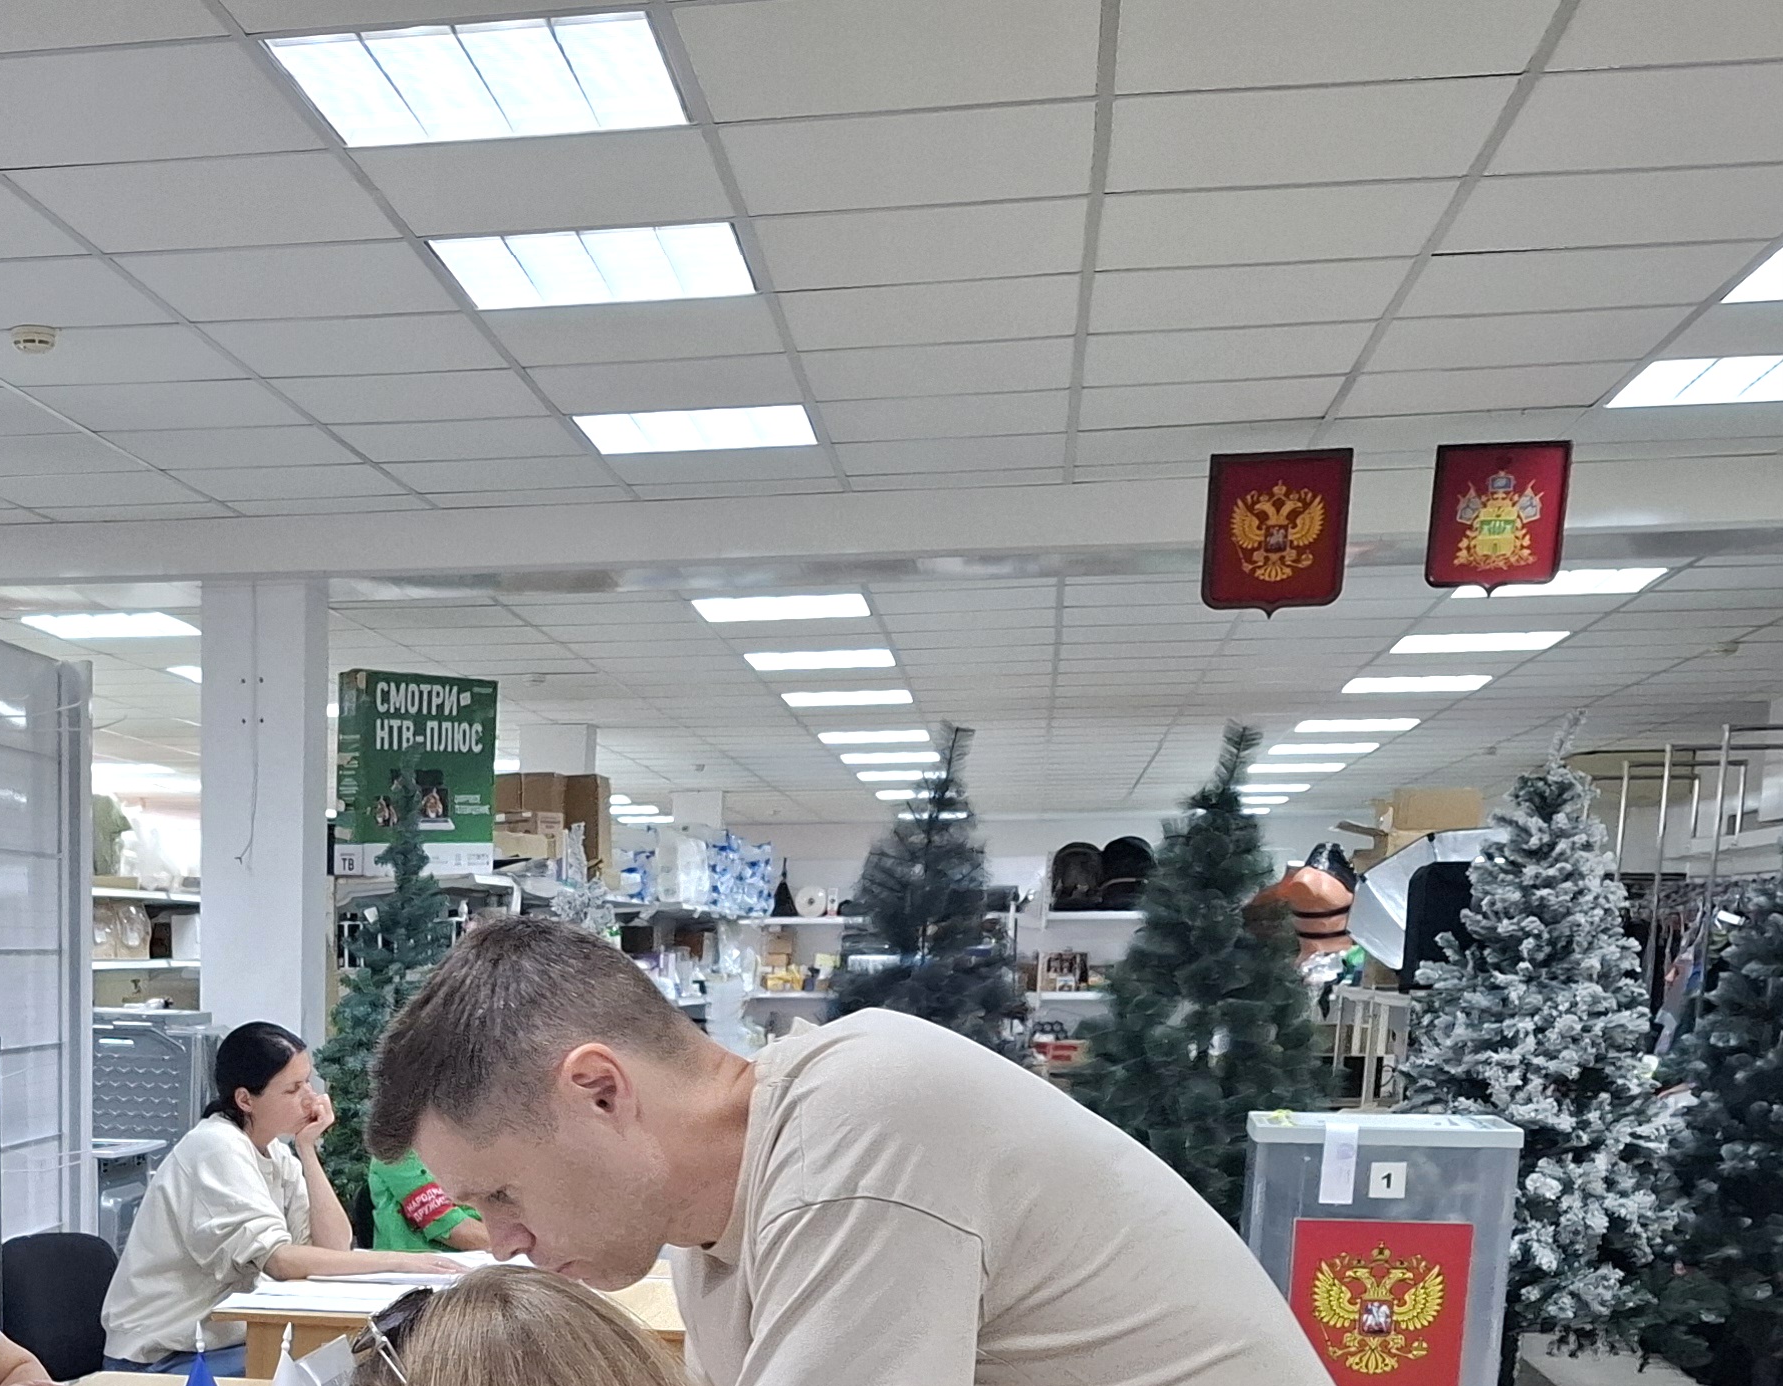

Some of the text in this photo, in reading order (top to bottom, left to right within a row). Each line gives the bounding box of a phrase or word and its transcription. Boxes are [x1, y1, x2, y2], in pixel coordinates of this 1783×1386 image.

[375, 719, 483, 753] НТВ-ПЛЮС
[341, 857, 355, 873] ТВ
[1381, 1172, 1393, 1189] 1
